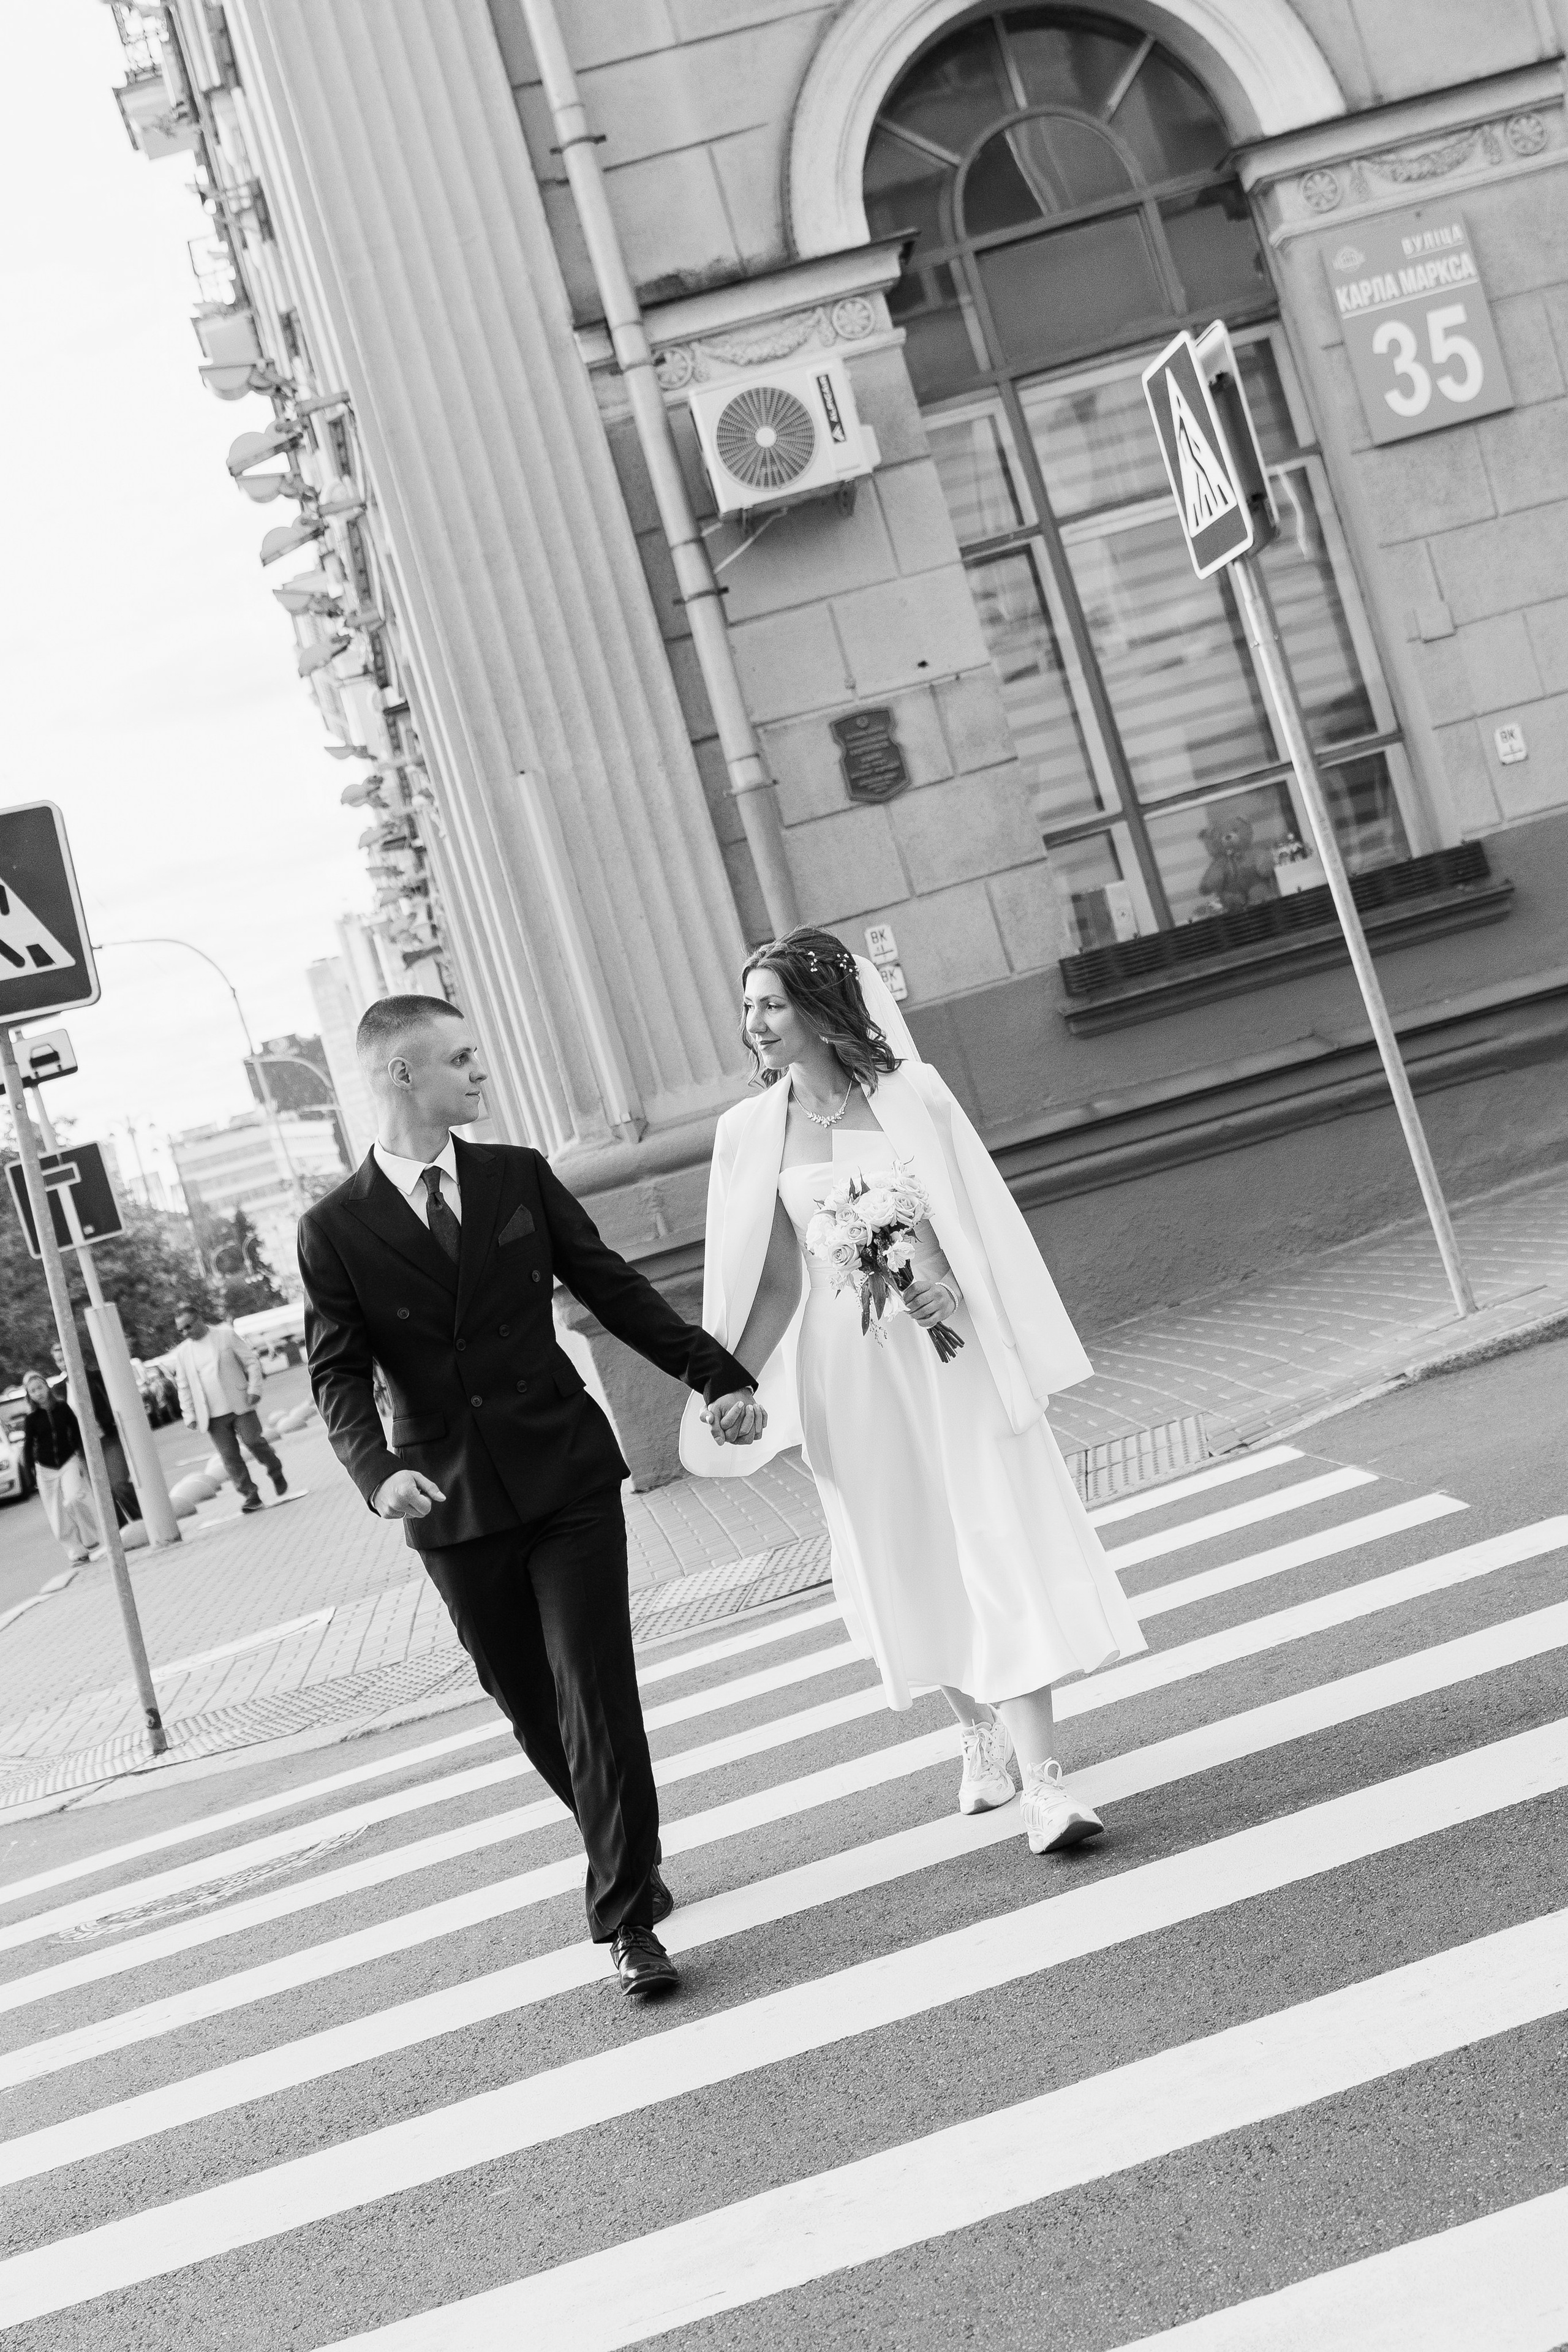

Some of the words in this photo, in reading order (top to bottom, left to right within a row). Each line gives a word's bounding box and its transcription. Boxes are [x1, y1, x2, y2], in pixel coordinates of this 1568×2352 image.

[1401, 224, 1464, 255] ВУЛІЦА
[1335, 273, 1400, 313] КАРЛА
[1397, 251, 1477, 295] МАРКСА
[1372, 303, 1484, 417] 35
